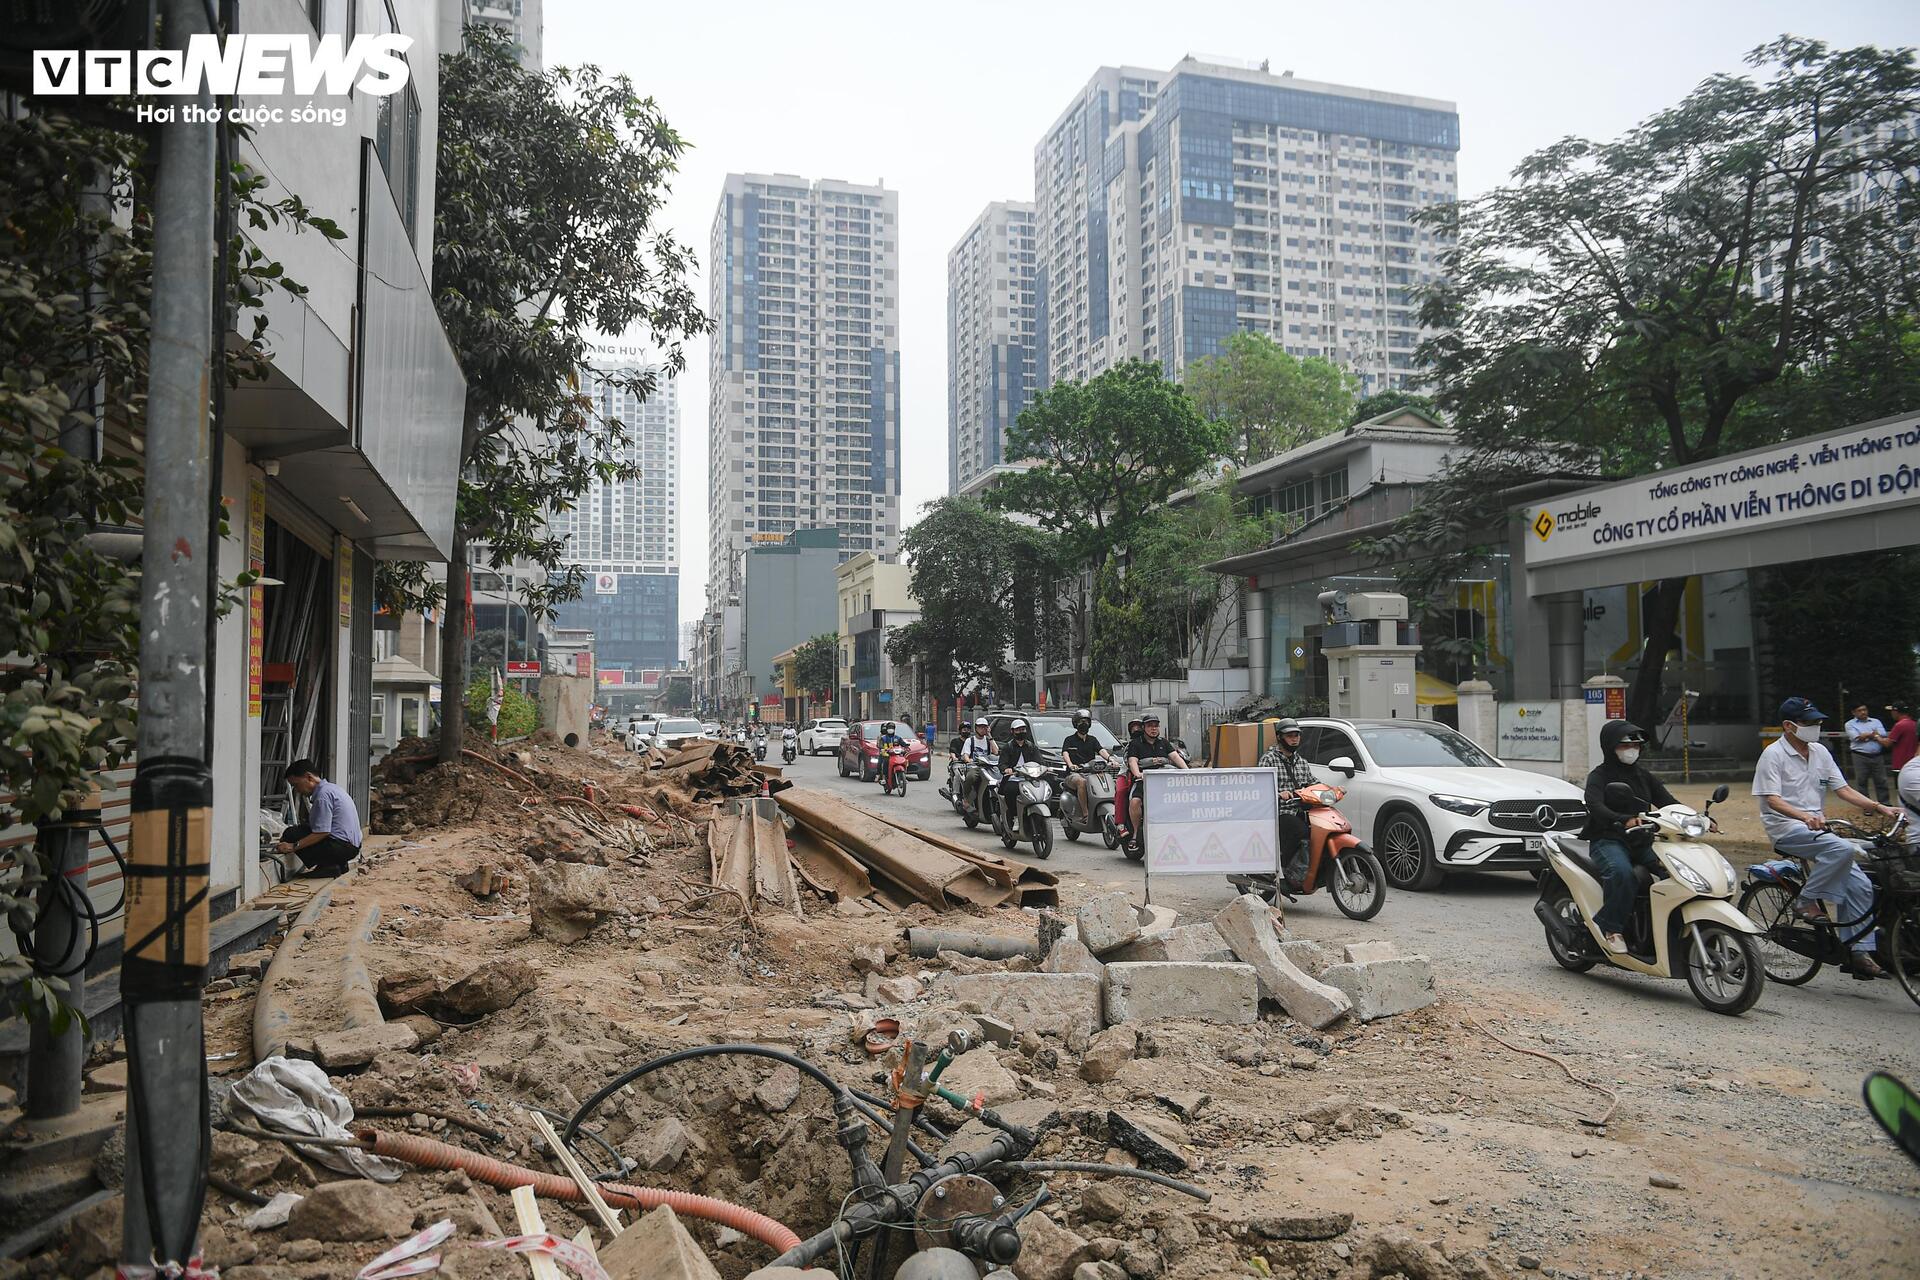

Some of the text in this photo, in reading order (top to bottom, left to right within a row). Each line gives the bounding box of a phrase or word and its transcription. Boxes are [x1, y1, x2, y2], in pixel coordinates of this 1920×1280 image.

[619, 346, 646, 356] HUY
[1680, 477, 1711, 494] CÔNG
[1713, 472, 1728, 486] TY
[1730, 466, 1764, 483] CÔNG
[1766, 453, 1799, 476] NGHỆ
[1809, 444, 1838, 466] VIỄN
[1842, 438, 1892, 459] THÔNG
[1557, 501, 1601, 524] mobile
[1593, 523, 1633, 544] CÔNG
[1636, 519, 1655, 537] TY
[1657, 506, 1679, 533] CỔ
[1682, 501, 1727, 529] PHẦN
[1731, 490, 1771, 518] VIỄN
[1775, 482, 1847, 512] THÔNG
[1851, 477, 1872, 499] DI
[1588, 690, 1602, 699] 105
